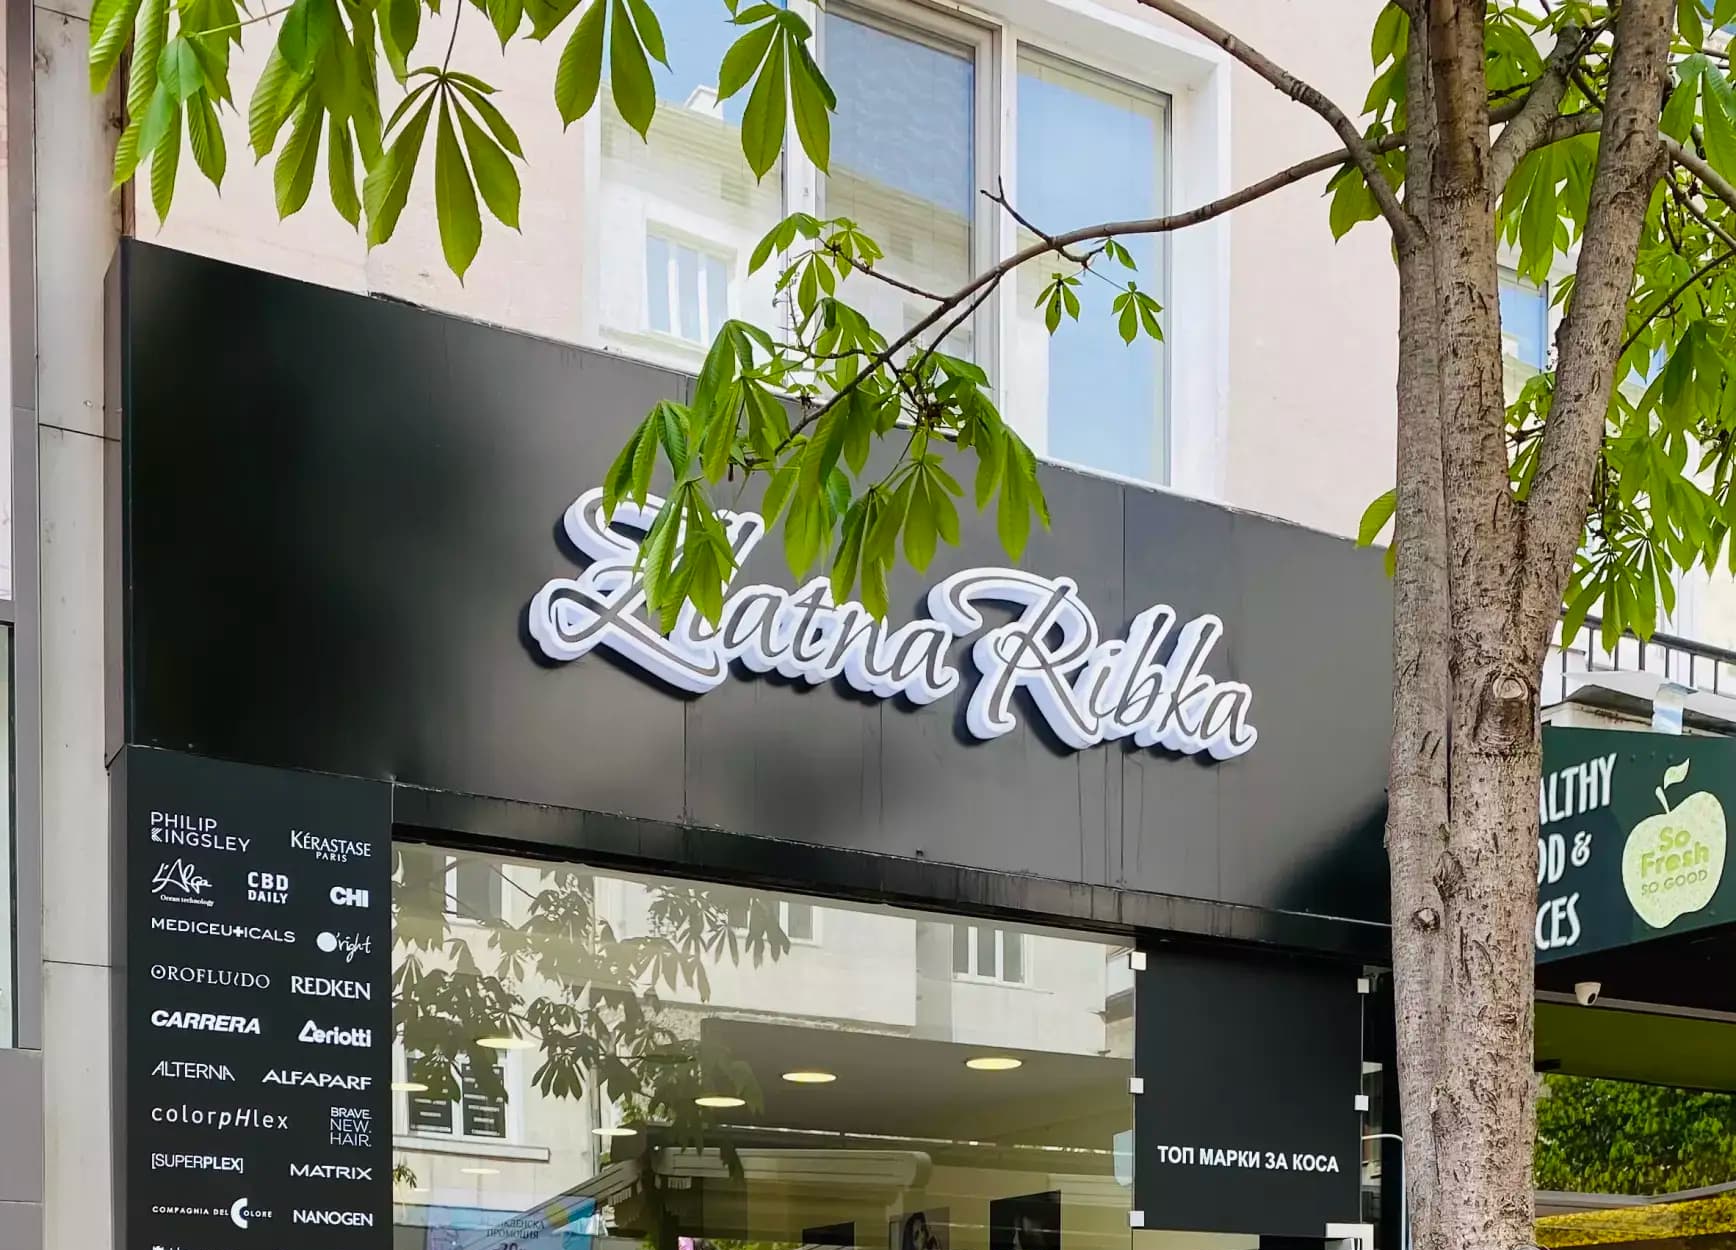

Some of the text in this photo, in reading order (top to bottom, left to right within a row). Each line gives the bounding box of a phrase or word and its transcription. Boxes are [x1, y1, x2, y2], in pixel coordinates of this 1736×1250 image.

[529, 486, 1258, 761] Zlatna Ribka
[151, 811, 217, 832] PHILIP
[151, 828, 251, 852] KINGSLEY
[291, 830, 371, 857] KÉRASTASE
[1571, 830, 1592, 867] &
[1660, 826, 1690, 851] So
[316, 852, 347, 862] PARIS
[1641, 841, 1710, 879] Fresh
[248, 872, 288, 891] CBD
[1641, 869, 1708, 896] SO GOOD
[248, 889, 288, 904] DAILY
[330, 886, 368, 907] CHI
[151, 964, 270, 989] OROFLUIDO
[291, 976, 371, 1000] REDKEN
[151, 1010, 261, 1034] CARRERA
[152, 1061, 235, 1081] ALTERNA
[262, 1070, 372, 1090] ALFAPARF
[151, 1105, 288, 1129] colorpHlex
[1157, 1145, 1339, 1173] ТОП МАРКИ ЗА КОСА
[290, 1164, 372, 1180] MATRIX
[152, 1206, 209, 1215] COMPAGNIA
[213, 1208, 229, 1216] DEL
[293, 1210, 373, 1226] NANOGEN
